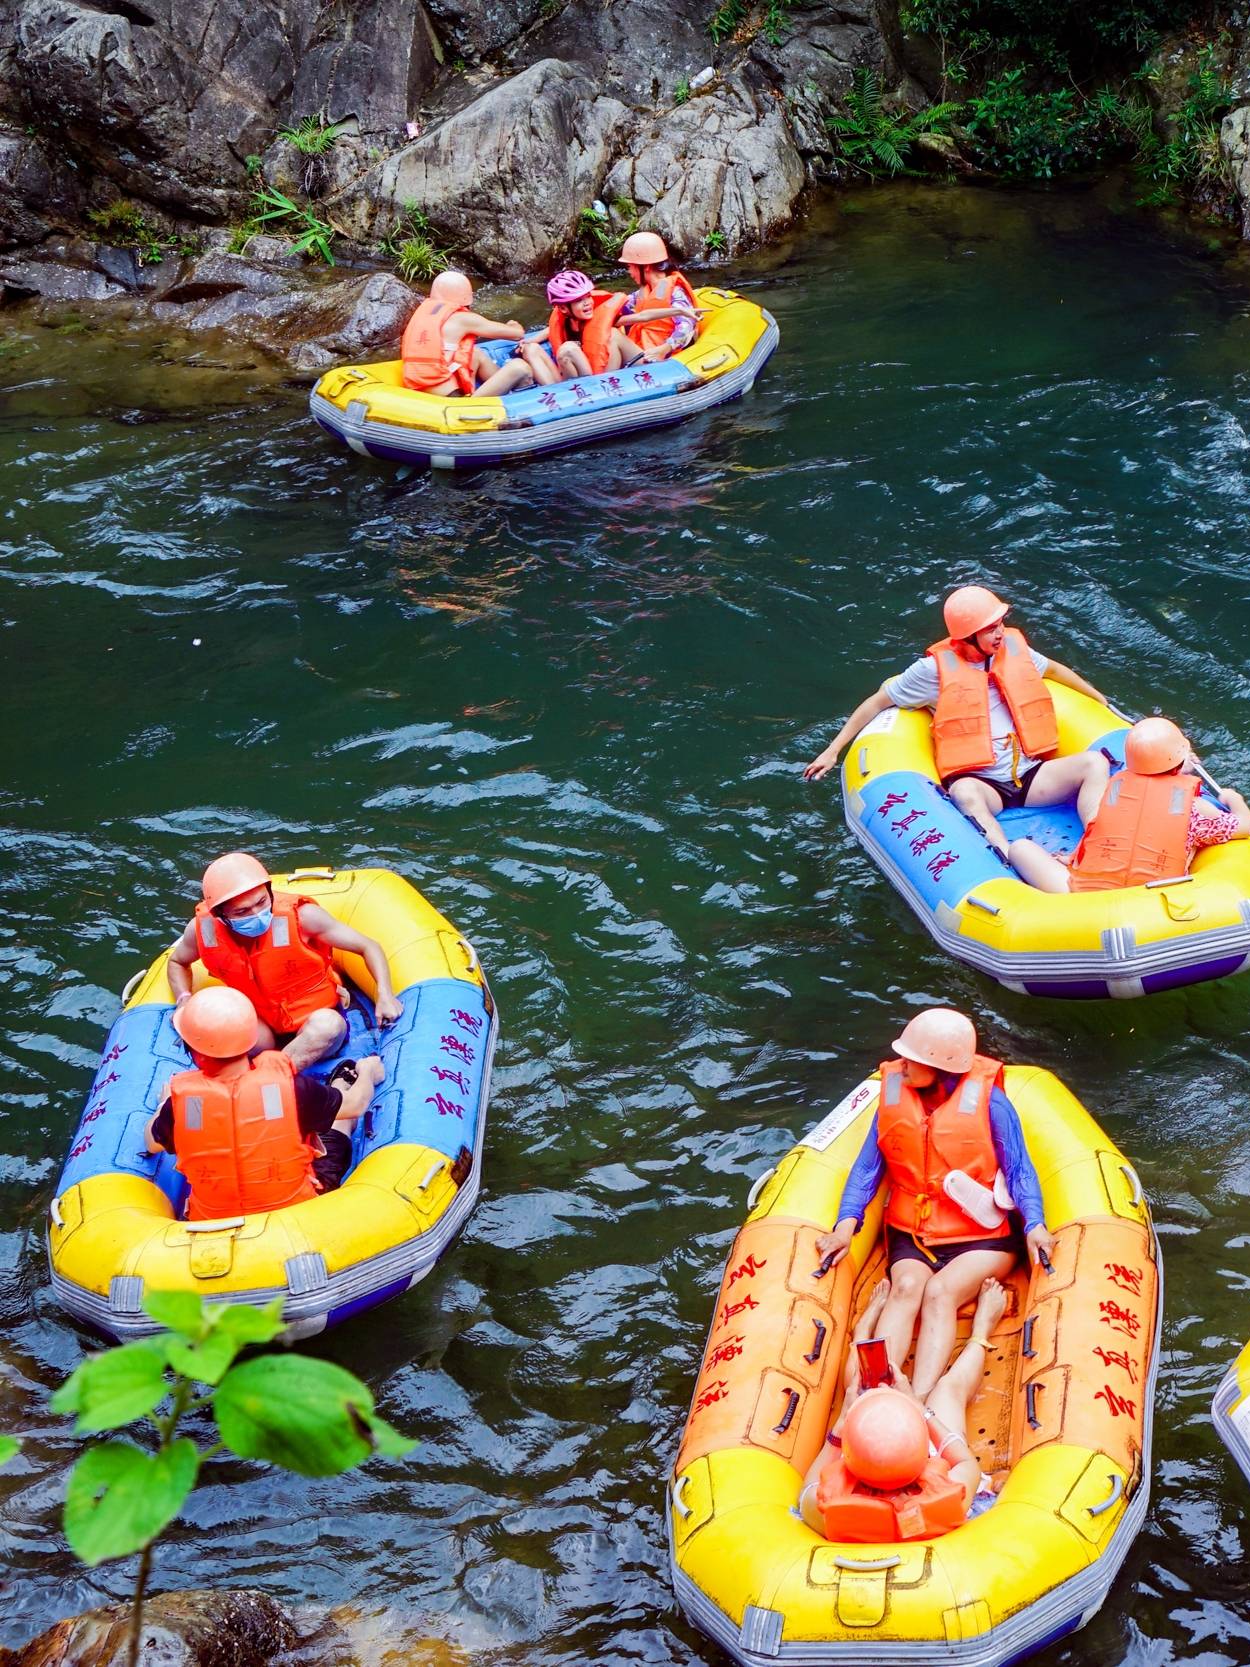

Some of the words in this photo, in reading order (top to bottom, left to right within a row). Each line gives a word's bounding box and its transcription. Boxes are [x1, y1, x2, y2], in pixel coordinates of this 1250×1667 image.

[537, 370, 664, 412] 玄真漂流
[877, 791, 960, 883] 玄真漂流
[425, 1009, 482, 1120] 玄真漂流
[690, 1253, 766, 1427] 玄真漂流
[1094, 1263, 1144, 1420] 玄真漂流
